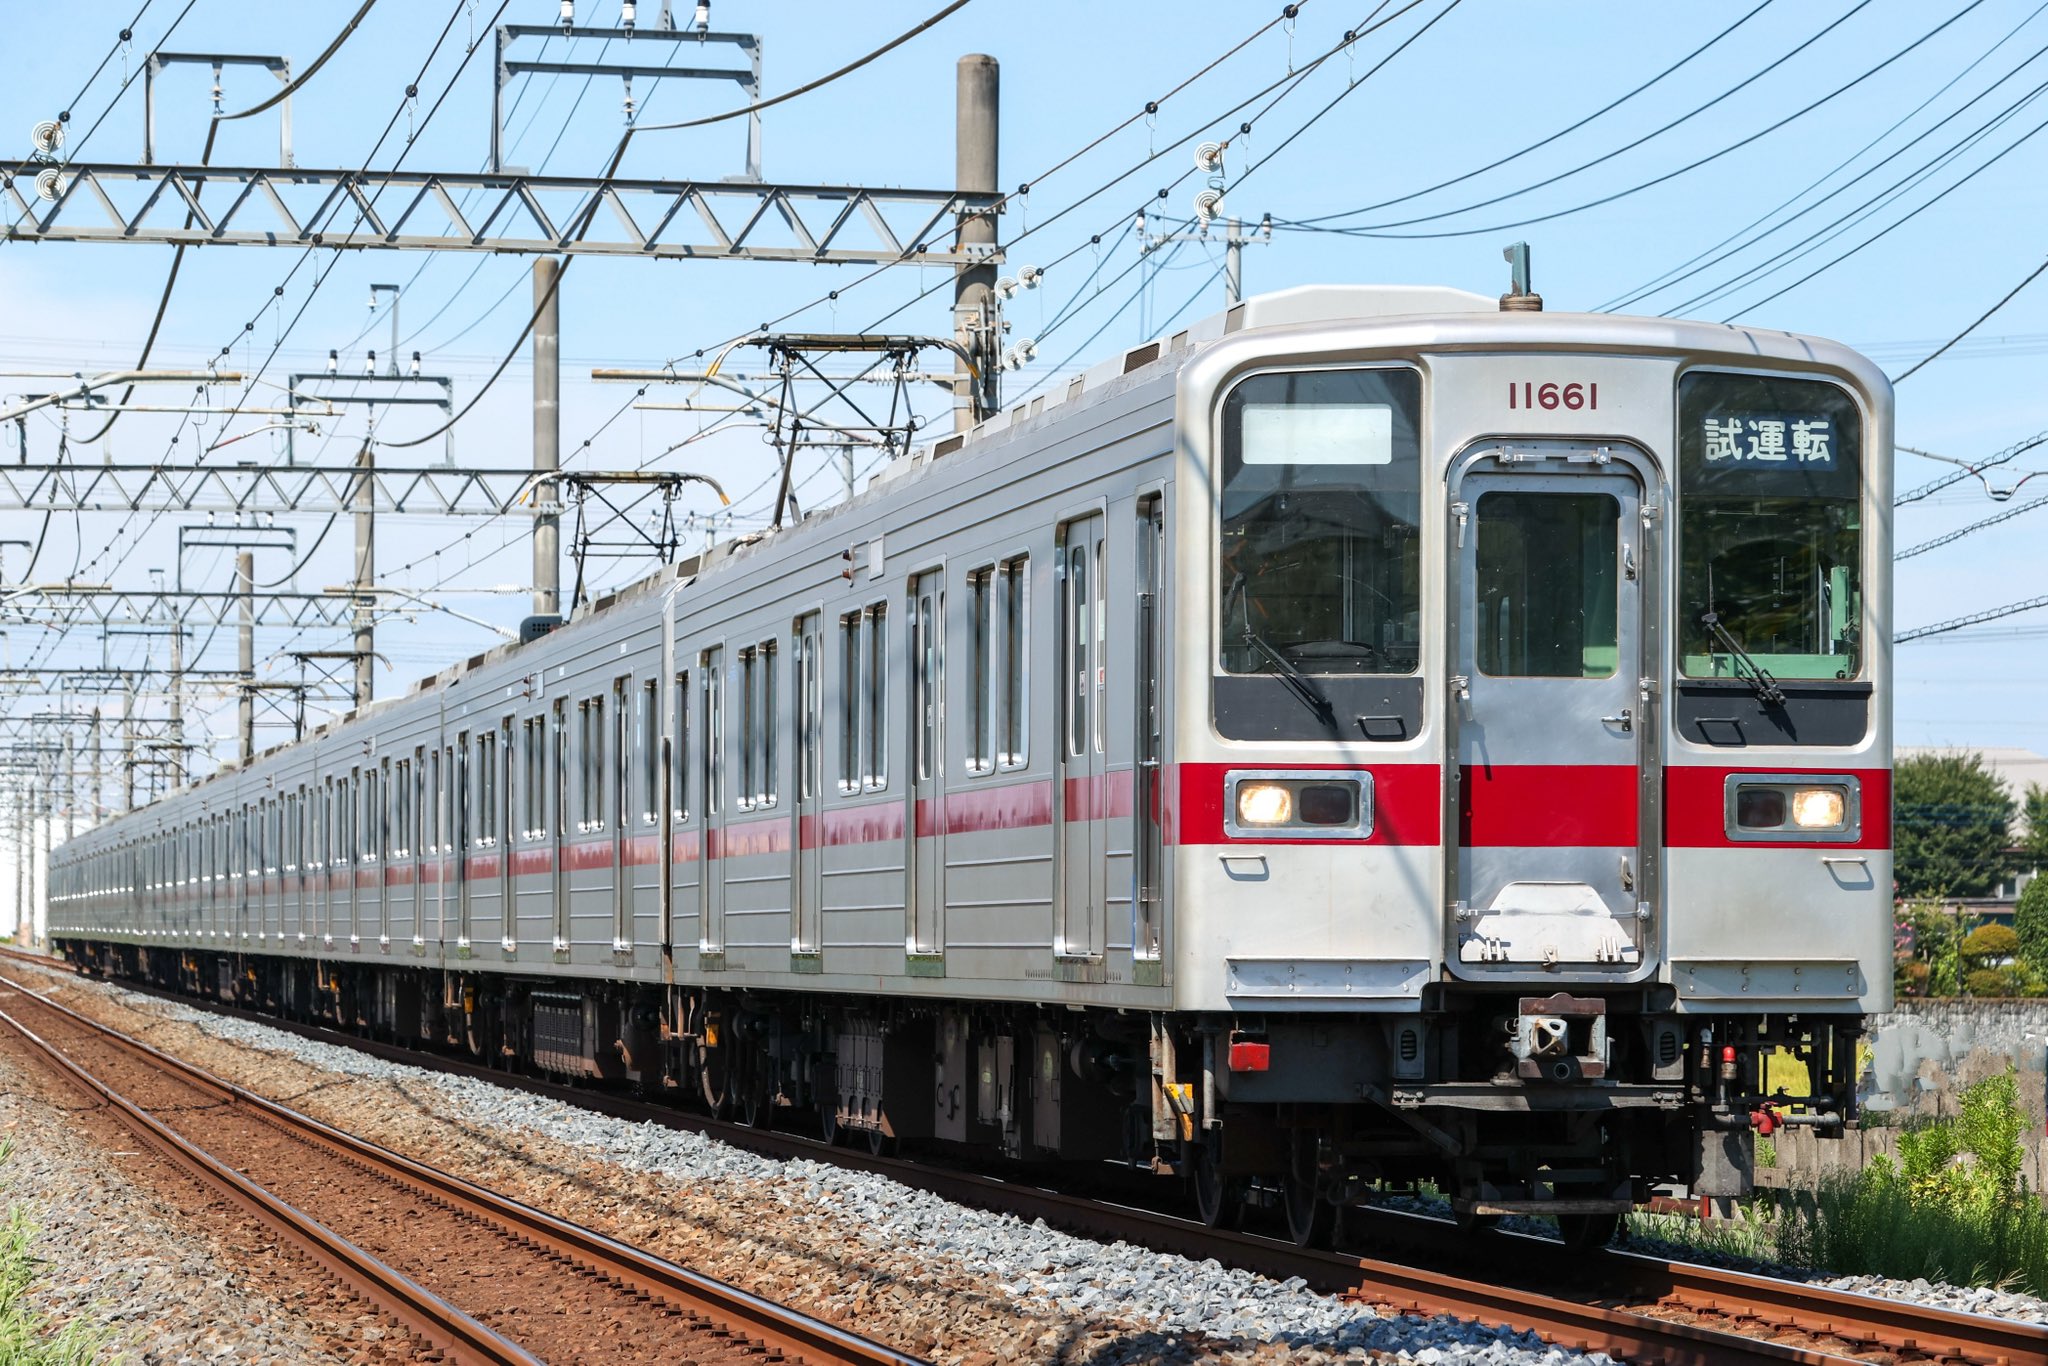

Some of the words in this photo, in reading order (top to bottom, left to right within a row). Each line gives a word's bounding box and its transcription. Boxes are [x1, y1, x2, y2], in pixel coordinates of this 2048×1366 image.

[1510, 382, 1597, 410] 11661
[1705, 417, 1831, 461] 試運転
